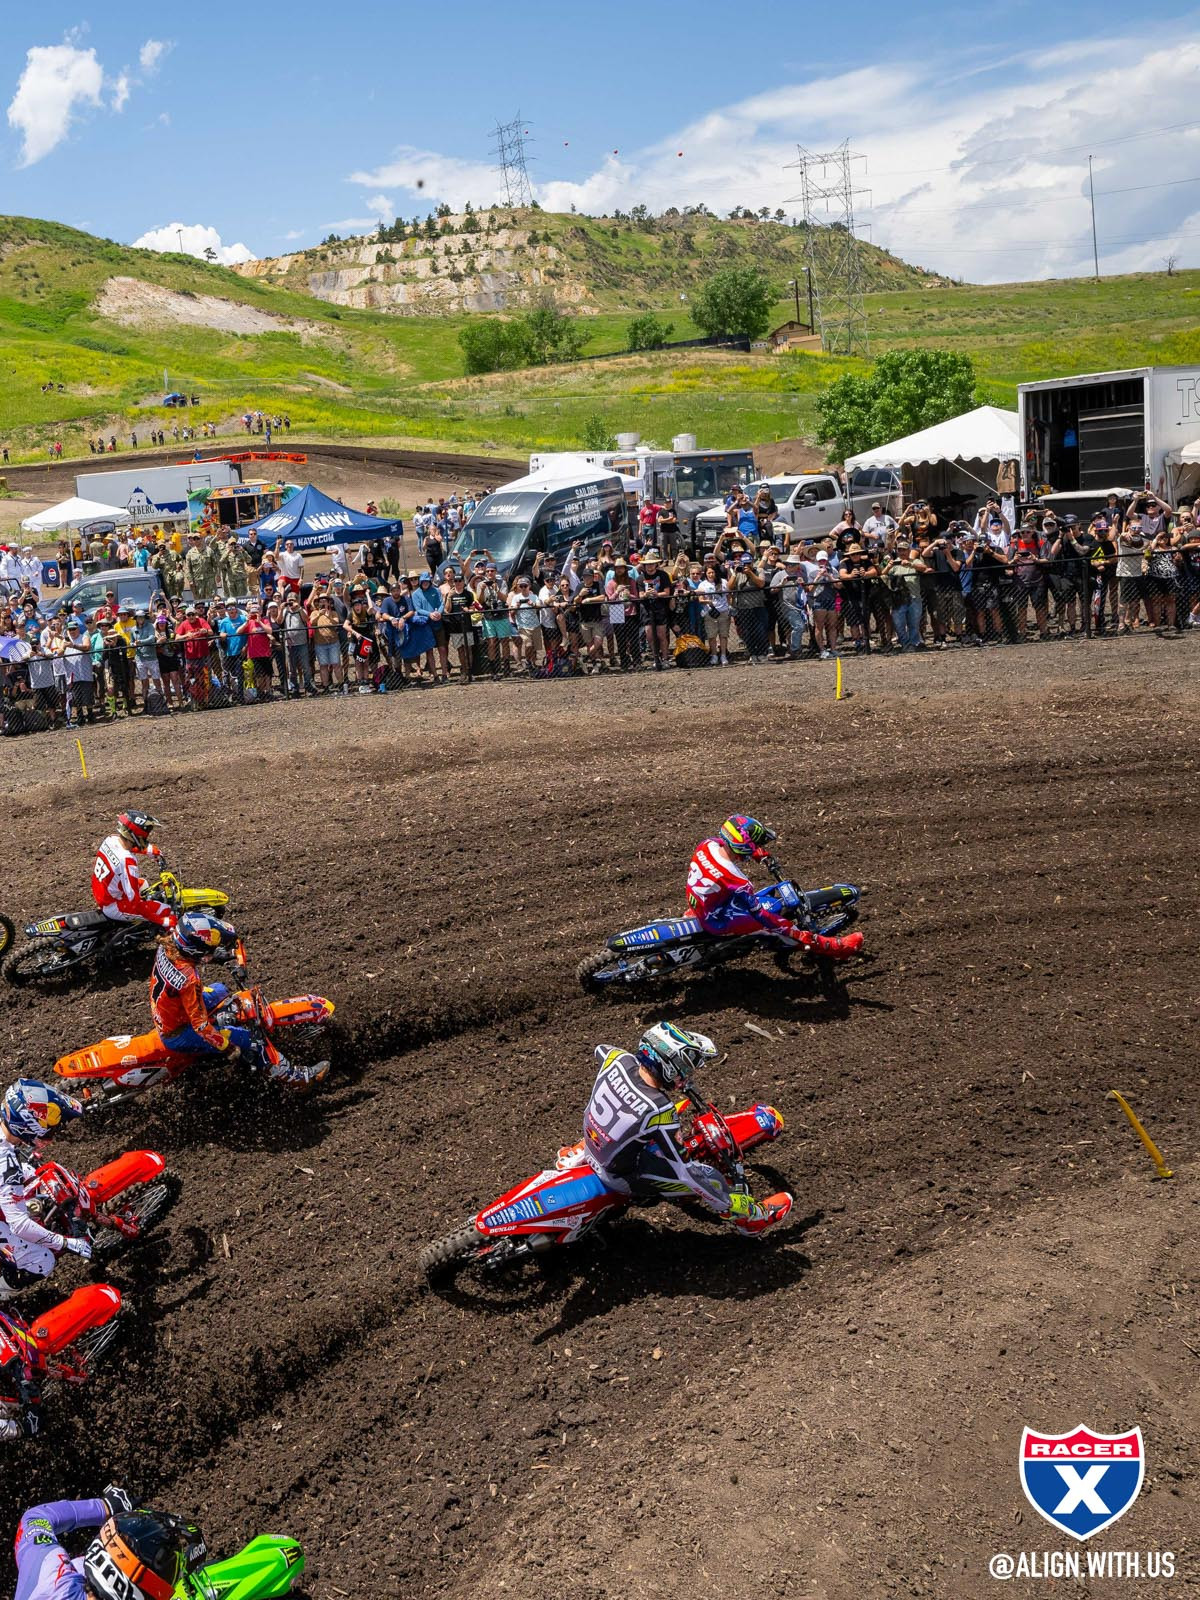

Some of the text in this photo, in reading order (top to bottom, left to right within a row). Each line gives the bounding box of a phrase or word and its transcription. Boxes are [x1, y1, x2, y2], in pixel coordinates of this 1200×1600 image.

[575, 484, 599, 499] SAILORS
[564, 498, 599, 514] AREN'T BORN
[305, 512, 354, 531] NAVY
[557, 515, 581, 531] THEY'RE
[299, 533, 335, 547] NAVY.COM
[134, 816, 147, 826] 87
[94, 856, 111, 883] 87
[696, 849, 724, 880] COOPER
[687, 861, 722, 896] 32
[80, 937, 98, 953] 87
[626, 943, 655, 952] DUNLOP
[152, 967, 167, 1005] 7
[607, 1067, 649, 1116] BARCIA
[590, 1080, 639, 1142] 51
[489, 1225, 518, 1235] DUNLOP
